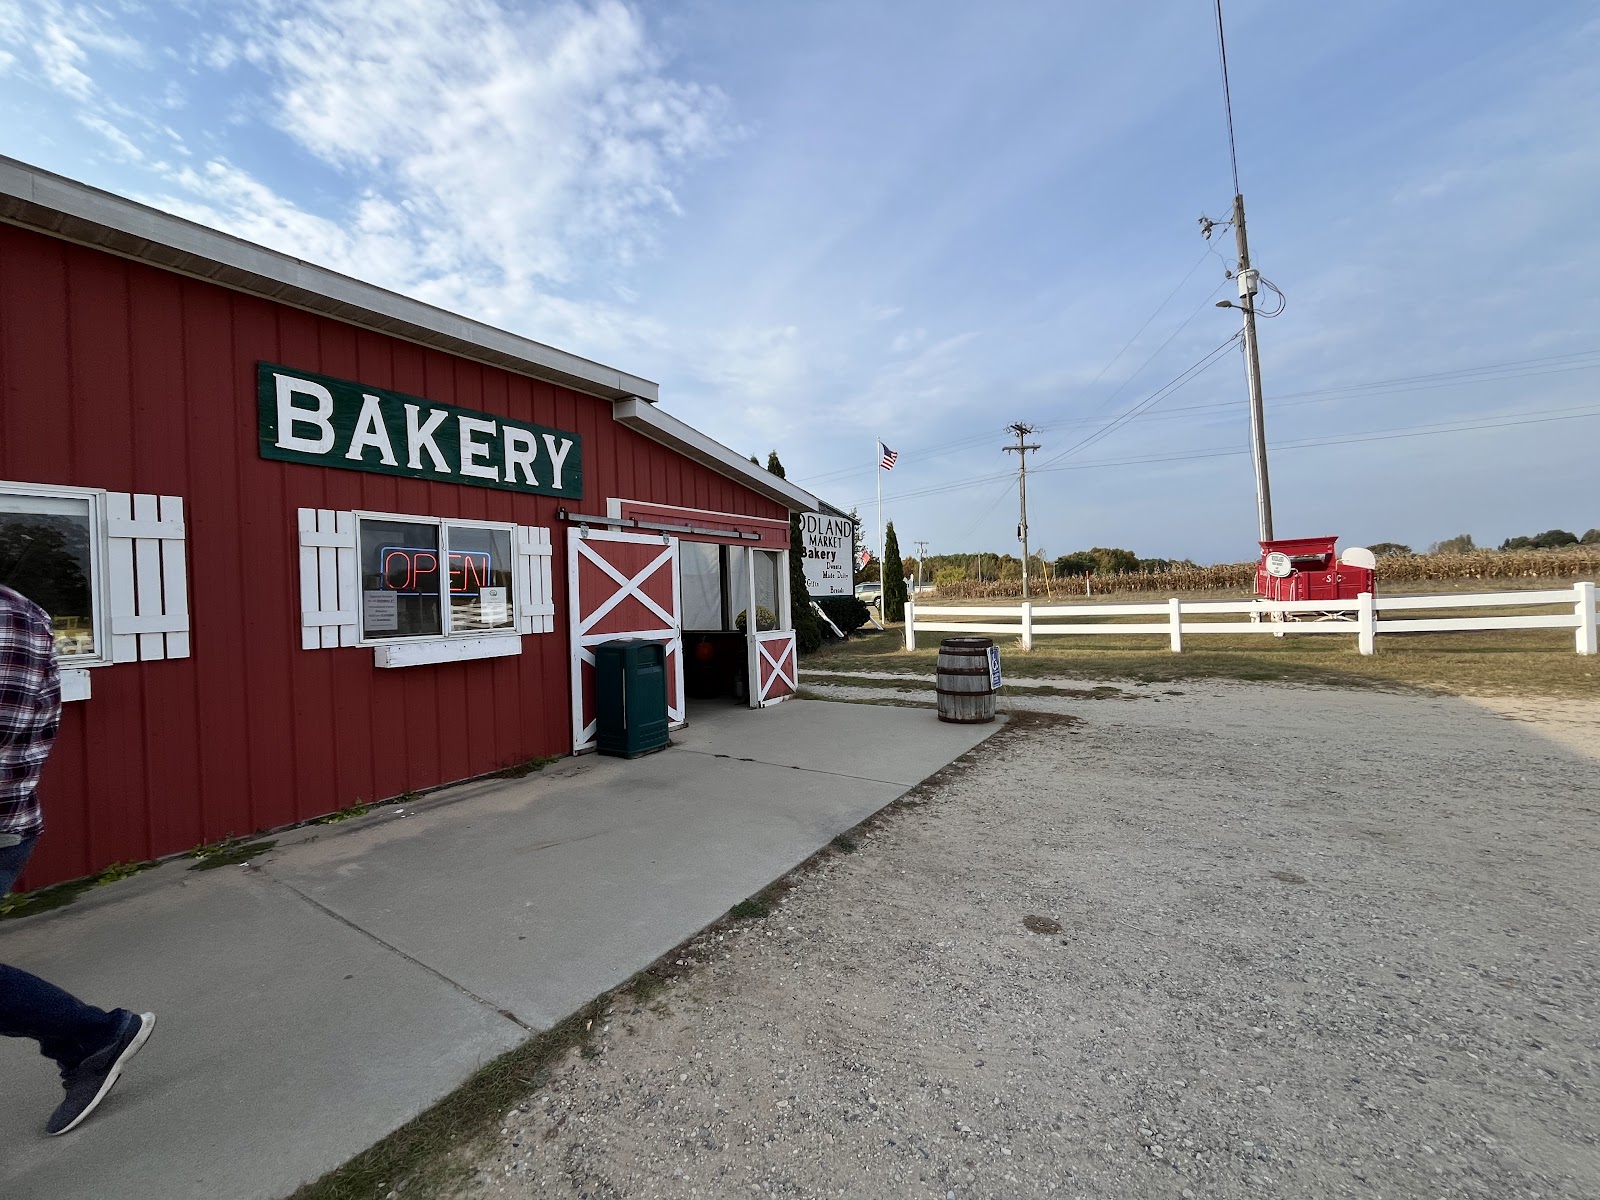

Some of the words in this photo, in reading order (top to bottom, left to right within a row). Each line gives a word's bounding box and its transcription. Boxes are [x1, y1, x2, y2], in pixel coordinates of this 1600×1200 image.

[273, 372, 573, 490] BAKERY
[809, 535, 842, 548] MARKET
[801, 547, 836, 562] Bakery
[385, 551, 486, 591] OPEN
[1326, 575, 1331, 583] S
